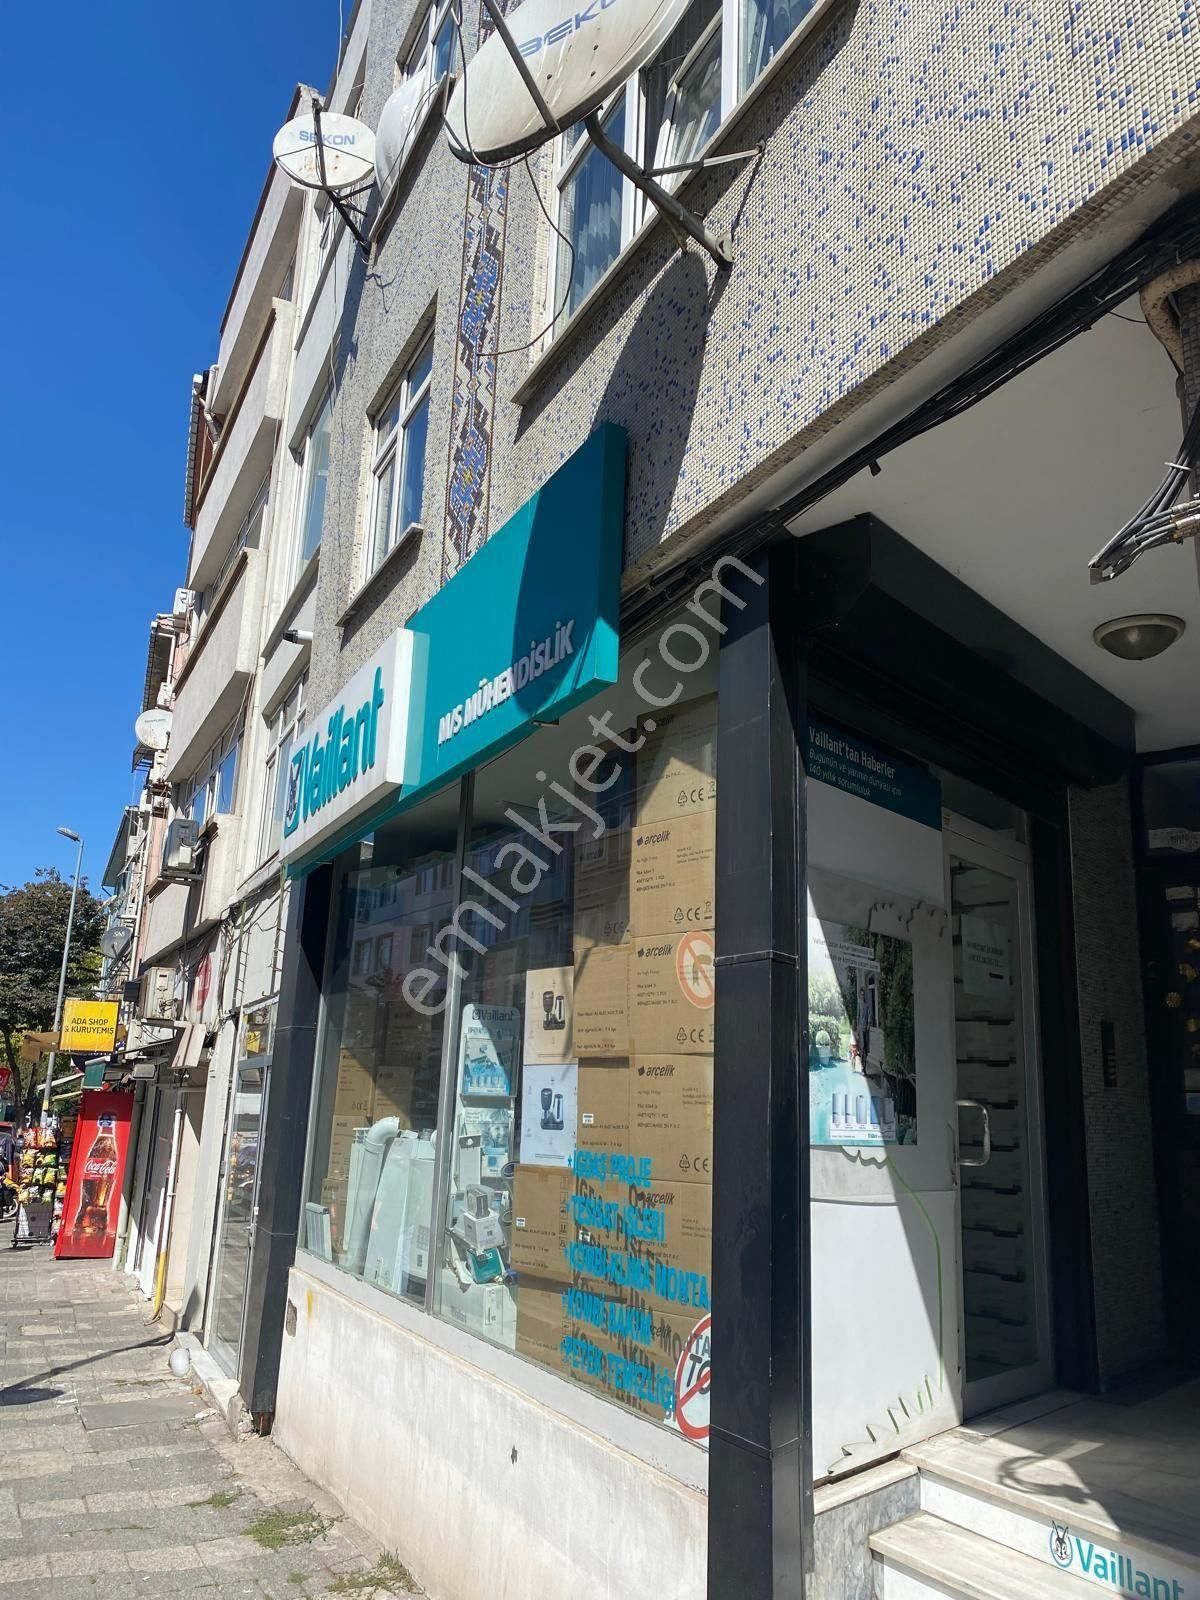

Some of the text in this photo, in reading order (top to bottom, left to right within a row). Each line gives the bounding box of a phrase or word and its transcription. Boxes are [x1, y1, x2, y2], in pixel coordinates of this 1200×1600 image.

[464, 619, 575, 727] MÜHENDİSLİK
[302, 666, 384, 823] Vaillant
[809, 726, 895, 779] Vaillant'tan Haberler
[809, 763, 821, 776] 140
[839, 763, 847, 773] ve
[644, 830, 671, 847] arçelik
[645, 944, 673, 960] arçelik
[72, 1017, 87, 1025] ADA
[481, 1009, 514, 1021] Vaillant
[646, 1064, 675, 1080] arçelik
[655, 1264, 709, 1310] MONTA
[1075, 1537, 1184, 1600] Vaillant
